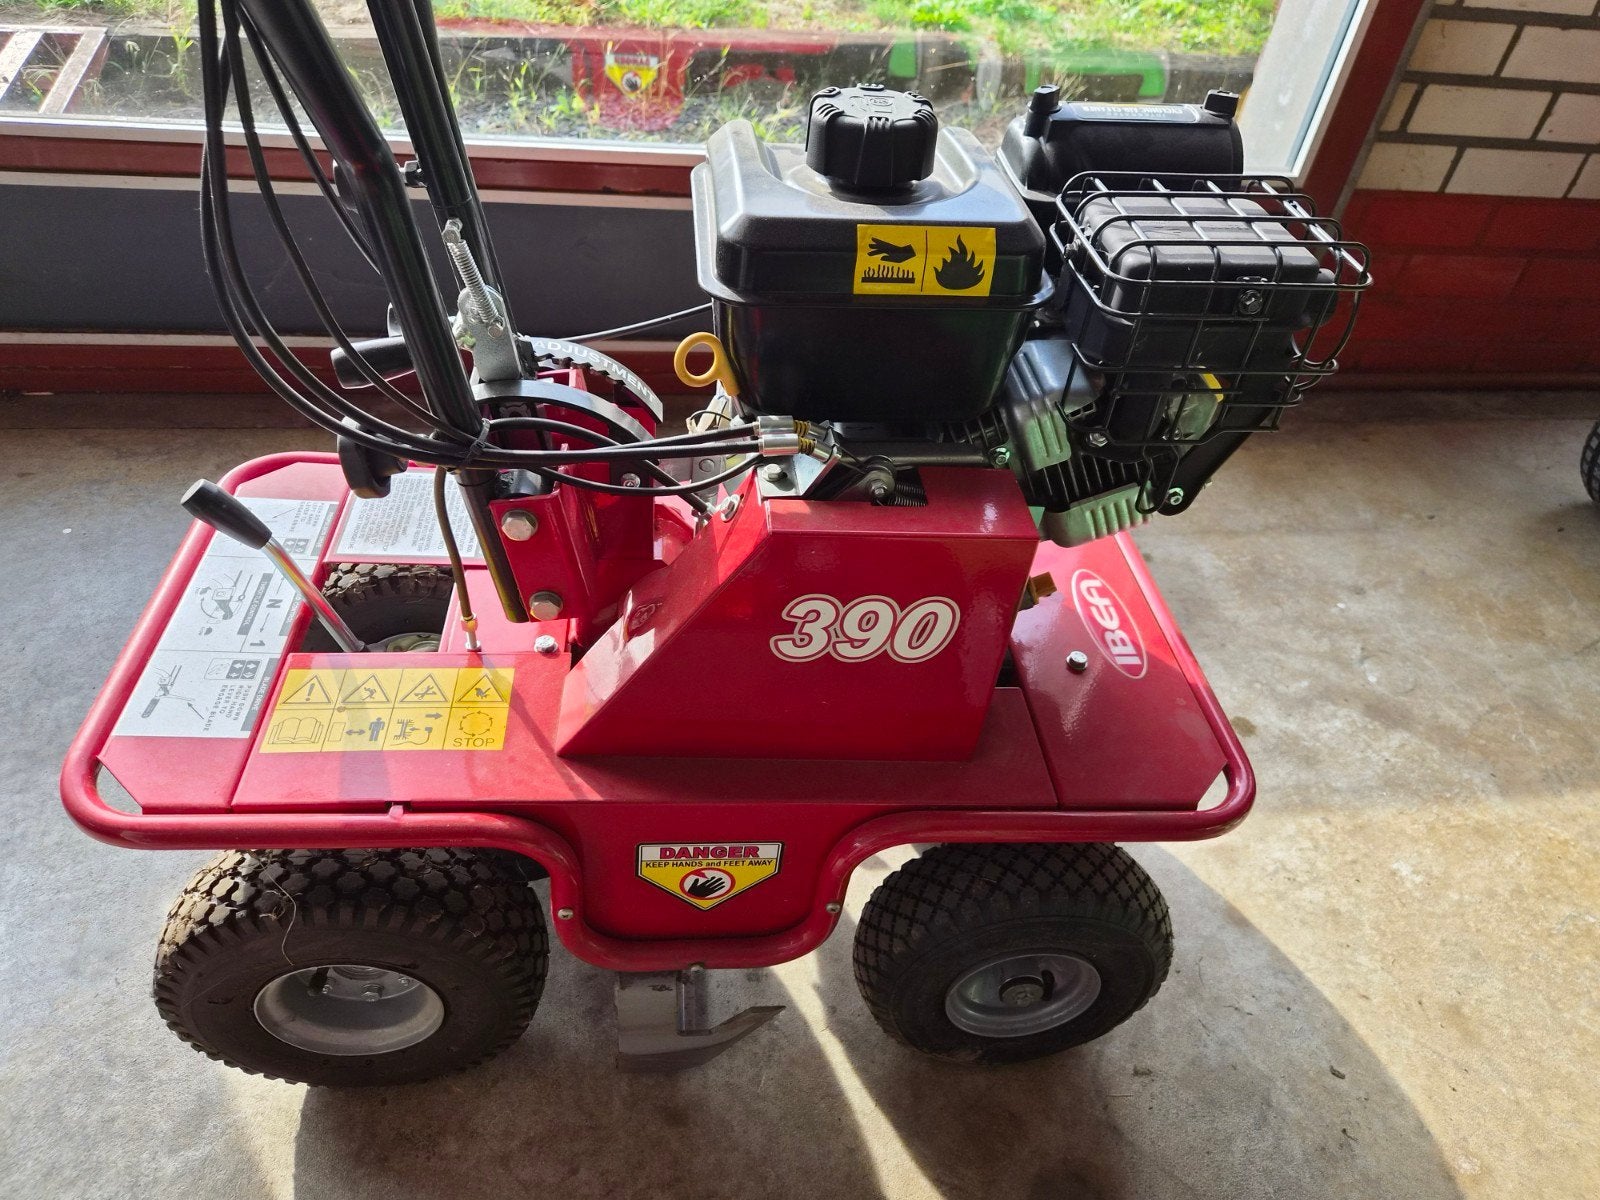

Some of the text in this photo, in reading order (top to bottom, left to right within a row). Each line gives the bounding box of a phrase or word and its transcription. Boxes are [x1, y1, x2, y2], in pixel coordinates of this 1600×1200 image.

[533, 340, 657, 403] ADJUSTMENT
[265, 599, 283, 608] N
[769, 594, 961, 664] 390
[453, 737, 495, 748] STOP
[660, 846, 760, 859] DANGER
